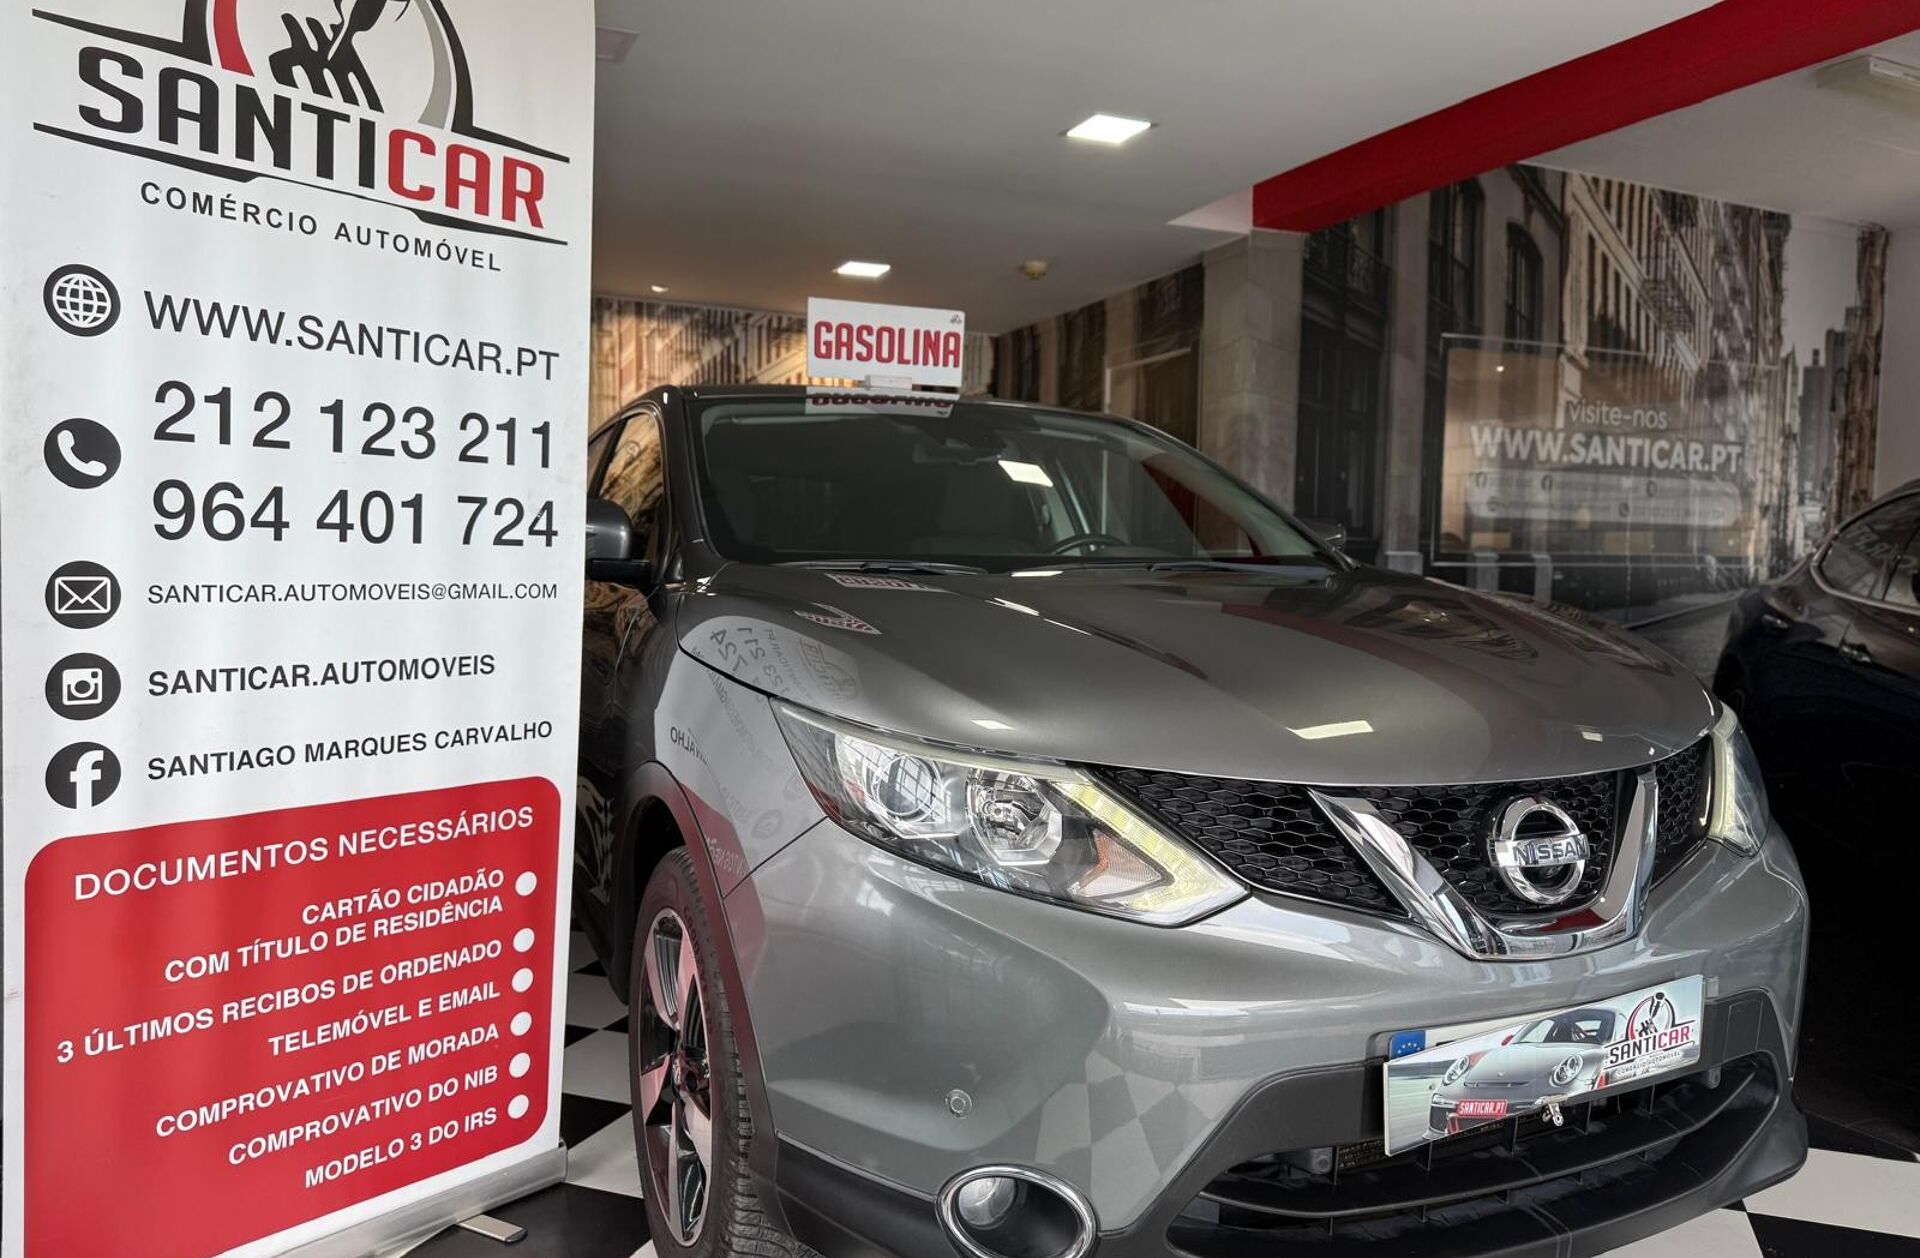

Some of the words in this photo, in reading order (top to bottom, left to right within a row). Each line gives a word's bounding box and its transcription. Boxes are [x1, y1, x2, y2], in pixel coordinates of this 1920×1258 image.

[78, 46, 544, 229] SANTICAR
[140, 181, 317, 235] COMÉRCIO
[334, 222, 501, 272] AUTOMÓVEL
[143, 290, 560, 381] WWW.SANTICAR.PT
[814, 320, 962, 369] GASOLINA
[153, 380, 291, 450] 212
[319, 398, 436, 460] 123
[458, 412, 550, 469] 211
[1469, 425, 1743, 474] WWW.SANTICAR.PT
[1569, 400, 1669, 430] visite-nos
[153, 478, 290, 542] 964
[316, 489, 423, 545] 401
[457, 495, 559, 548] 724
[148, 583, 557, 604] SANTICAR.AUTOMOVEIS@GMAIL.COM
[148, 654, 495, 697] SANTICAR.AUTOMOVEIS
[148, 745, 296, 780] SANTIAGO
[305, 732, 427, 763] MARQUES
[434, 720, 553, 750] CARVALHO
[75, 837, 329, 901] DOCUMENTOS
[338, 806, 533, 857] NECESSÁRIOS
[1512, 835, 1587, 865] NISSAN
[302, 888, 401, 925] CARTÃO
[407, 867, 505, 904] CIDADÃO
[164, 950, 230, 983] COM
[237, 930, 329, 967] TÍTULO
[335, 922, 367, 947] DE
[373, 895, 503, 938] RESIDÊNCIA
[57, 1040, 74, 1063] 3
[84, 1007, 214, 1056] ÚLTIMOS
[222, 979, 336, 1024] RECIBOS
[342, 969, 374, 995] DE
[379, 939, 502, 985] ORDENADO
[267, 1004, 412, 1056] TELEMÓVEL
[418, 997, 433, 1018] E
[438, 981, 501, 1013] EMAIL
[155, 1061, 365, 1137] COMPROVATIVO
[371, 1049, 402, 1076] DE
[408, 1023, 499, 1065] MORADA
[1609, 1025, 1691, 1064] SANTICAR
[228, 1088, 422, 1165] COMPROVATIVO
[428, 1077, 459, 1102] DO
[464, 1065, 498, 1091] NIB
[1460, 1101, 1506, 1115] SANTICAR.PT
[305, 1138, 405, 1189] MODELO
[410, 1132, 422, 1151] 3
[428, 1120, 459, 1145] DO
[464, 1107, 497, 1133] IRS
